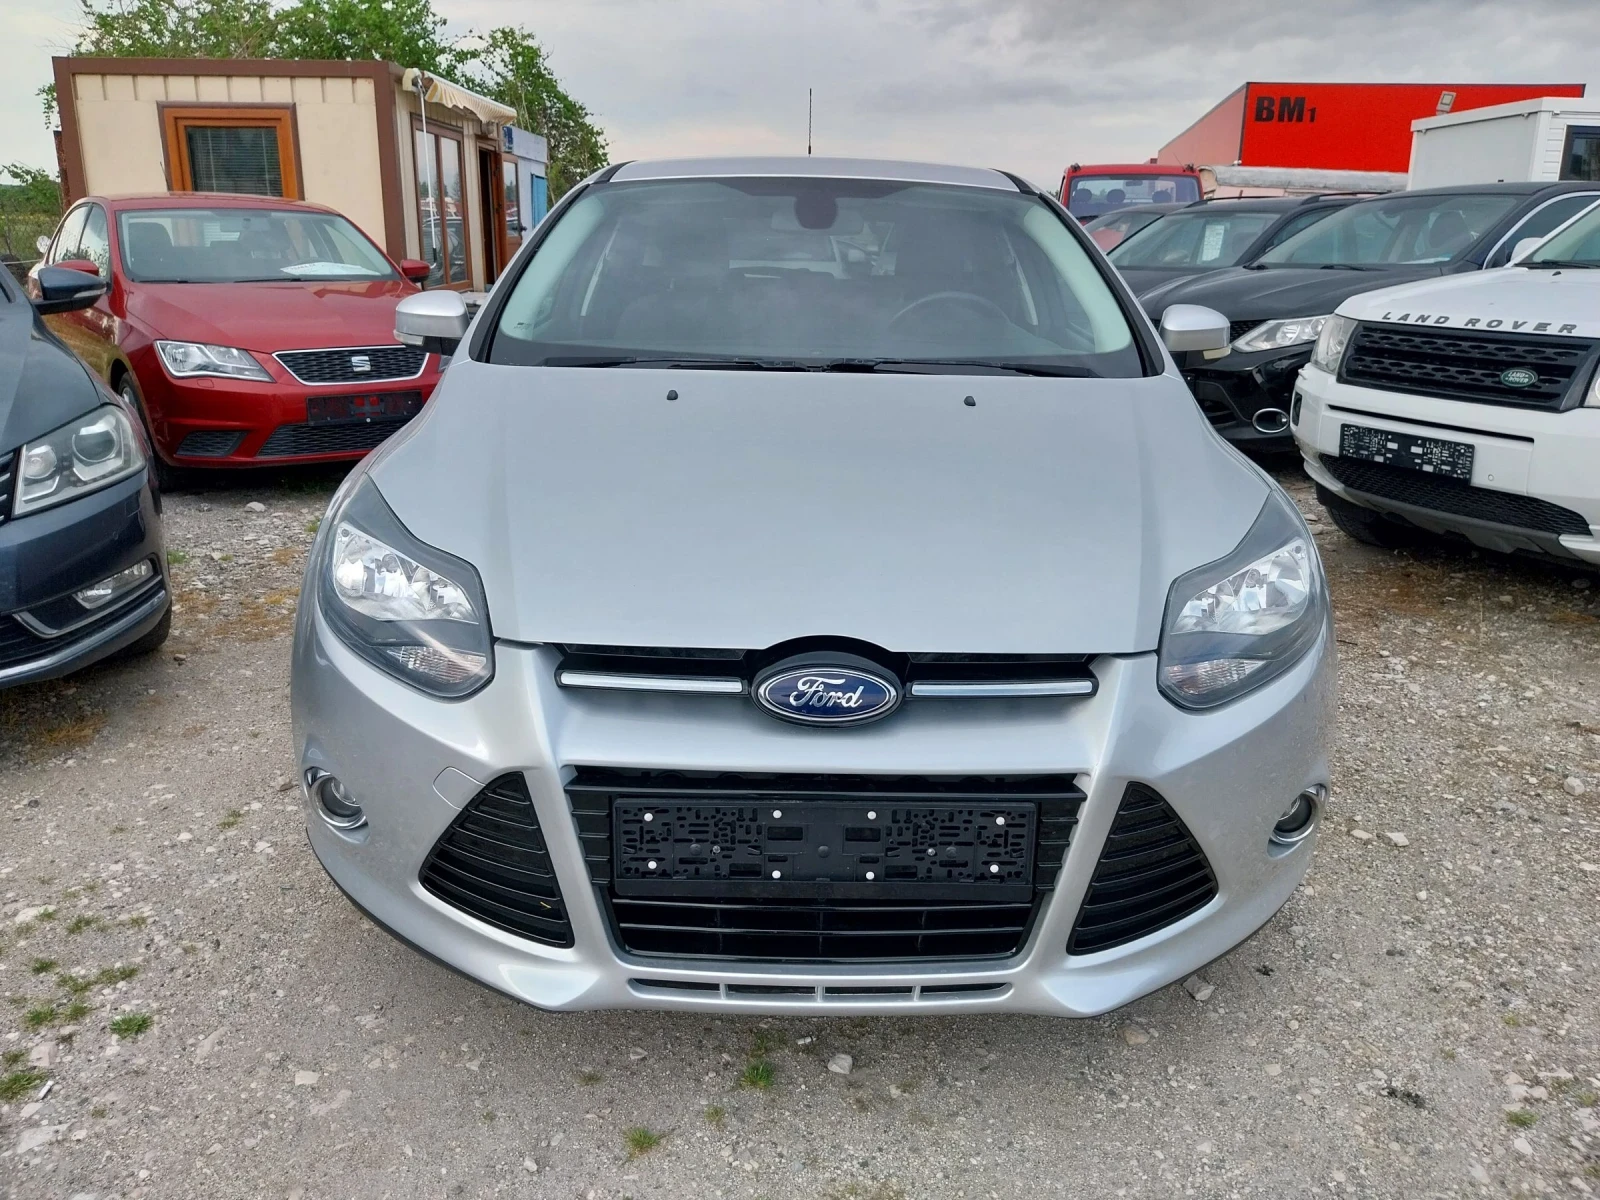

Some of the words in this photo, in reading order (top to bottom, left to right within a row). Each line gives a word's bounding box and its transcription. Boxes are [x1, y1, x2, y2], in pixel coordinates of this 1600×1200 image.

[1382, 311, 1450, 325] LAND
[1464, 317, 1578, 334] ROVER
[789, 676, 865, 708] Ford
